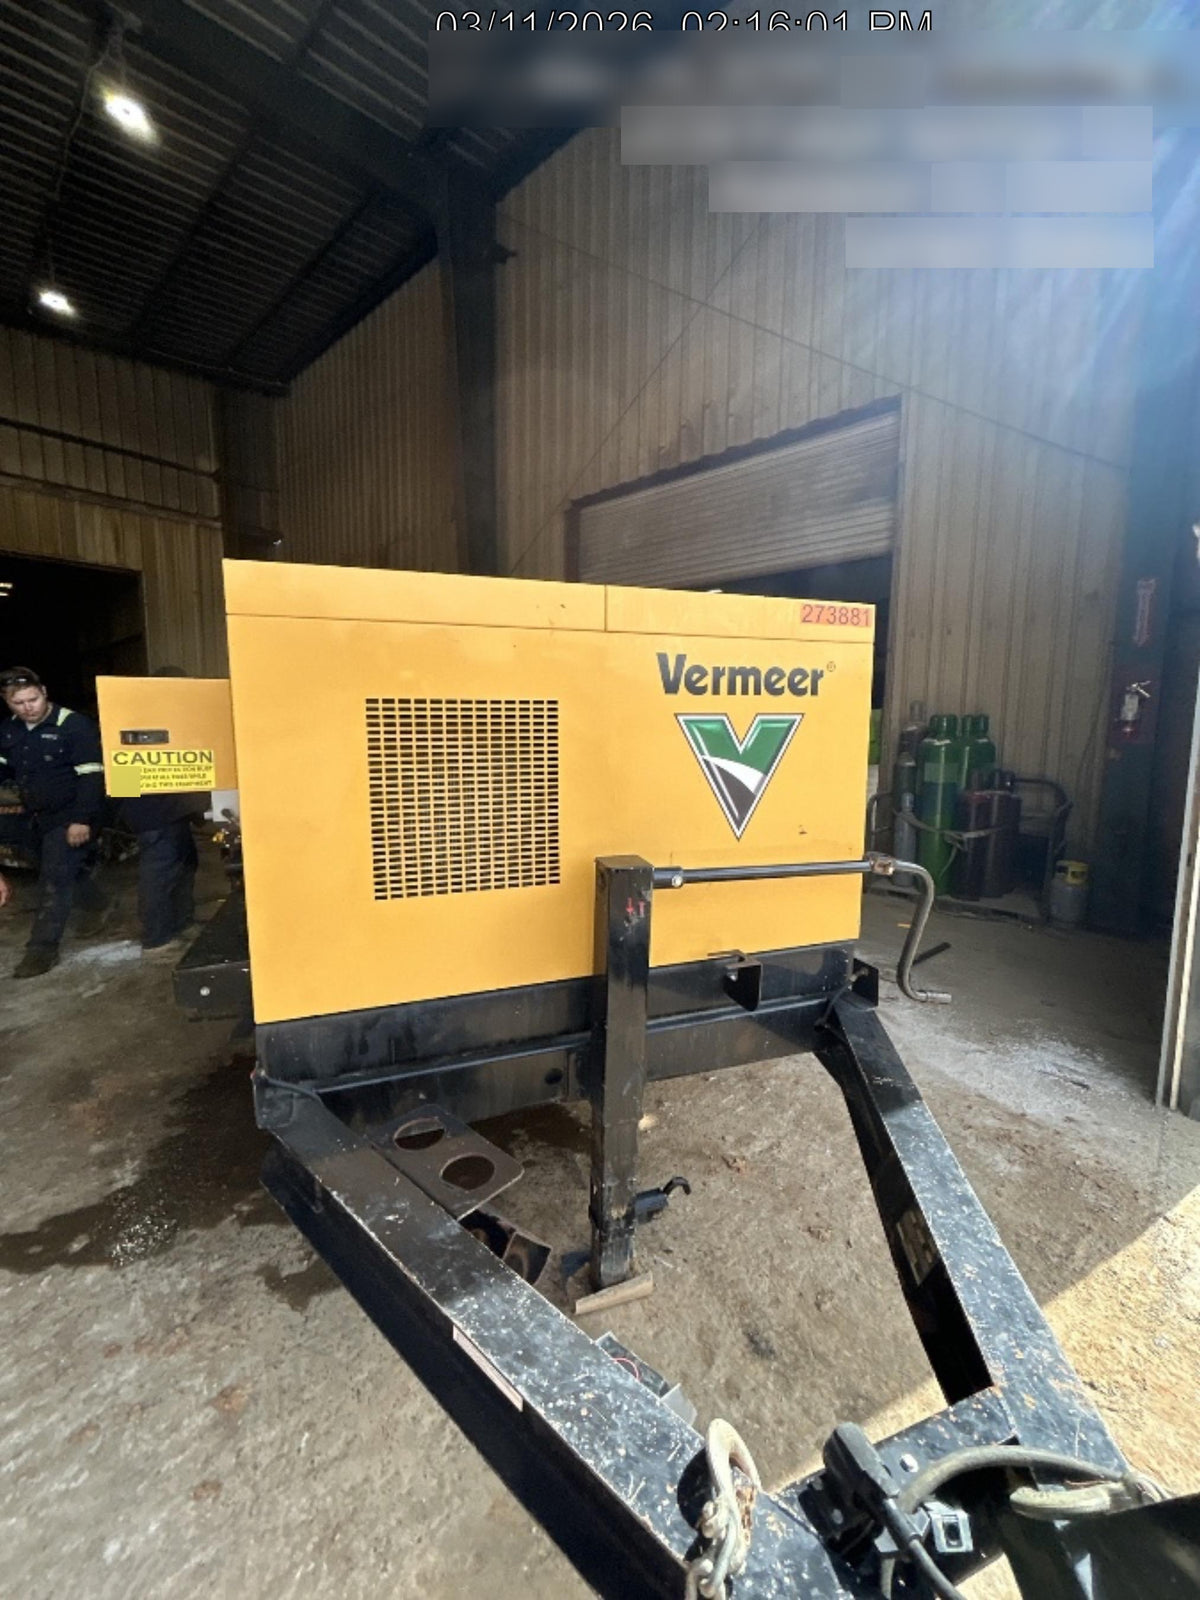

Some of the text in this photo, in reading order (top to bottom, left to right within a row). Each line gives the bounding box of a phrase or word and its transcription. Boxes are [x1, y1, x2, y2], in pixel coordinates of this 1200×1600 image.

[801, 604, 869, 626] 273881
[656, 652, 824, 697] Vermeer
[113, 751, 212, 765] CAUTION
